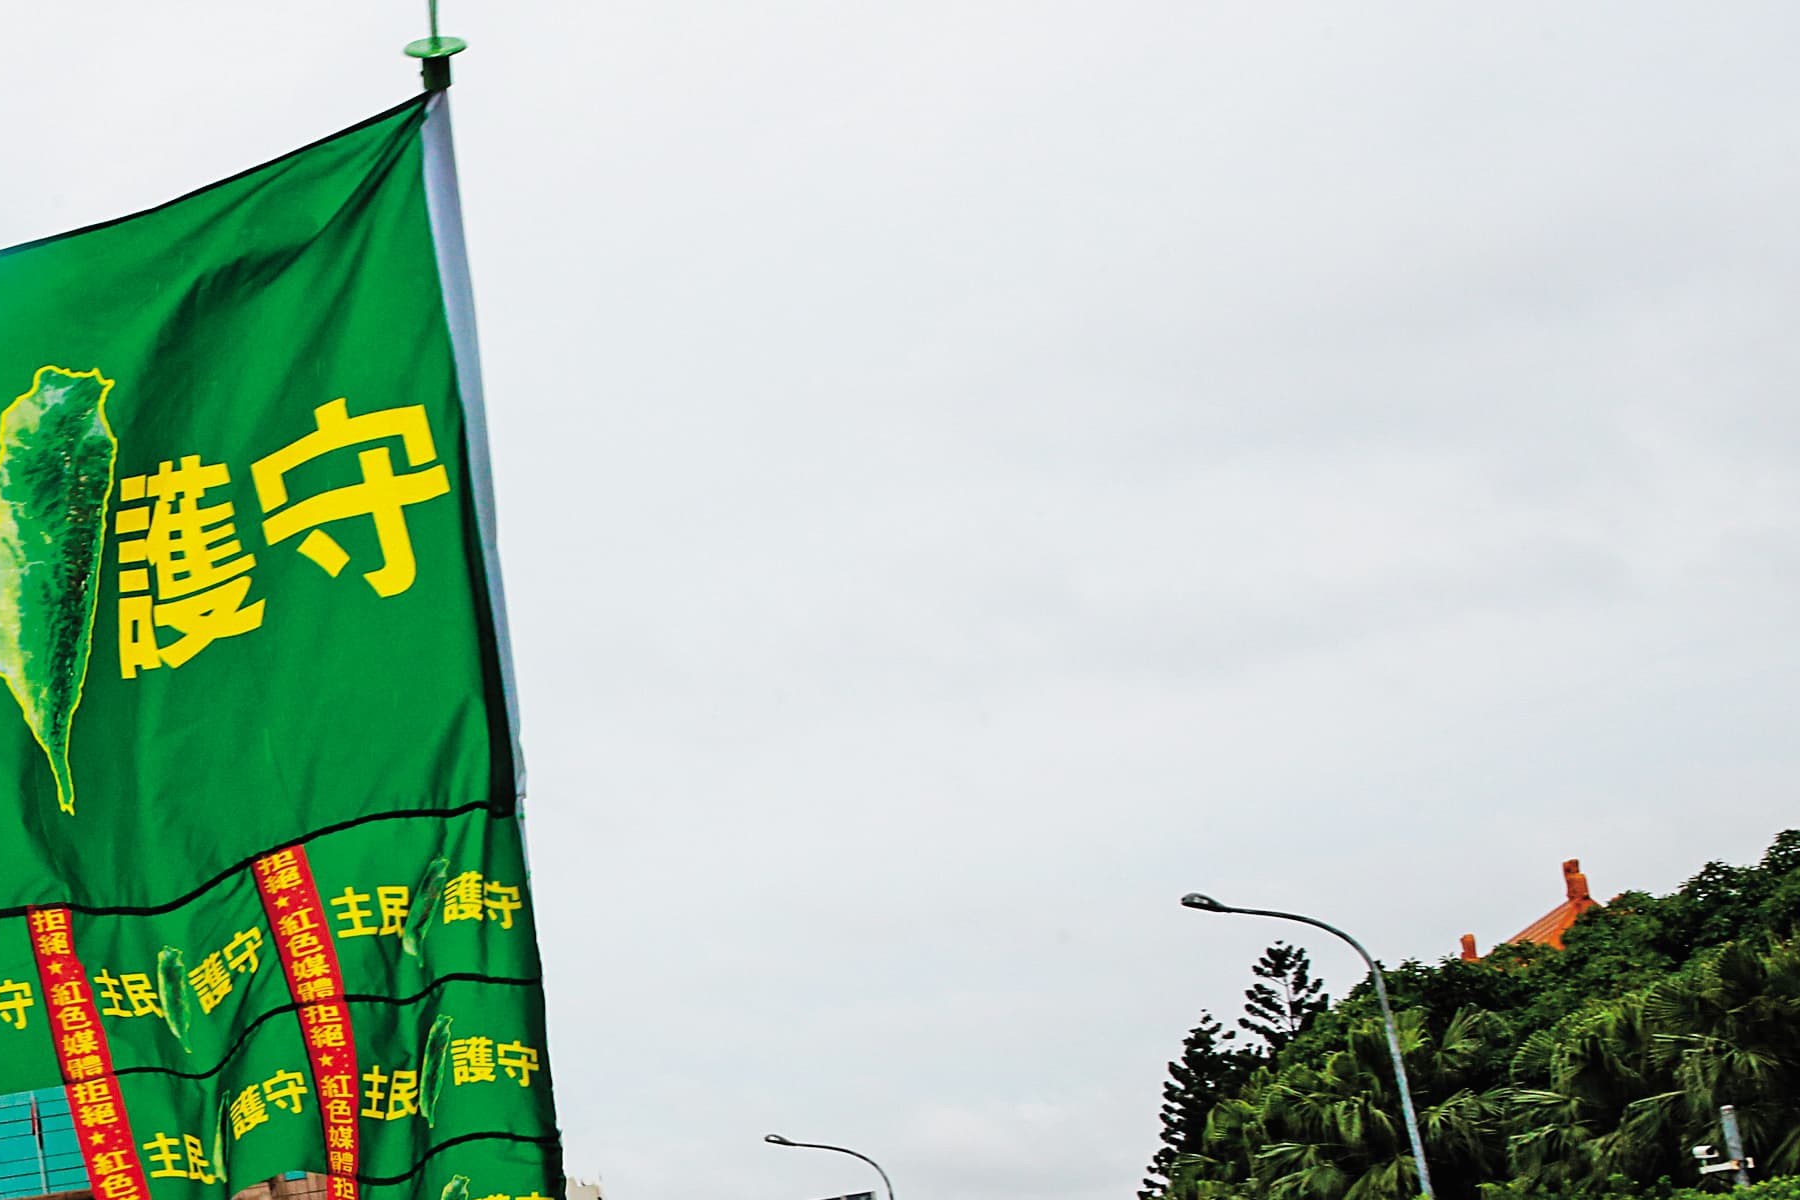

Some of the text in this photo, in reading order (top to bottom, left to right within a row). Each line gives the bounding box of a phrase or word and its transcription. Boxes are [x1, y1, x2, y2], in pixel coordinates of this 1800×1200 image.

[32, 909, 104, 1081] 拒絕 紅色媒體
[257, 850, 335, 1003] 拒絕 紅色媒體
[71, 1077, 118, 1127] 拒絕
[303, 1004, 355, 1175] 拒絕 紅色媒體
